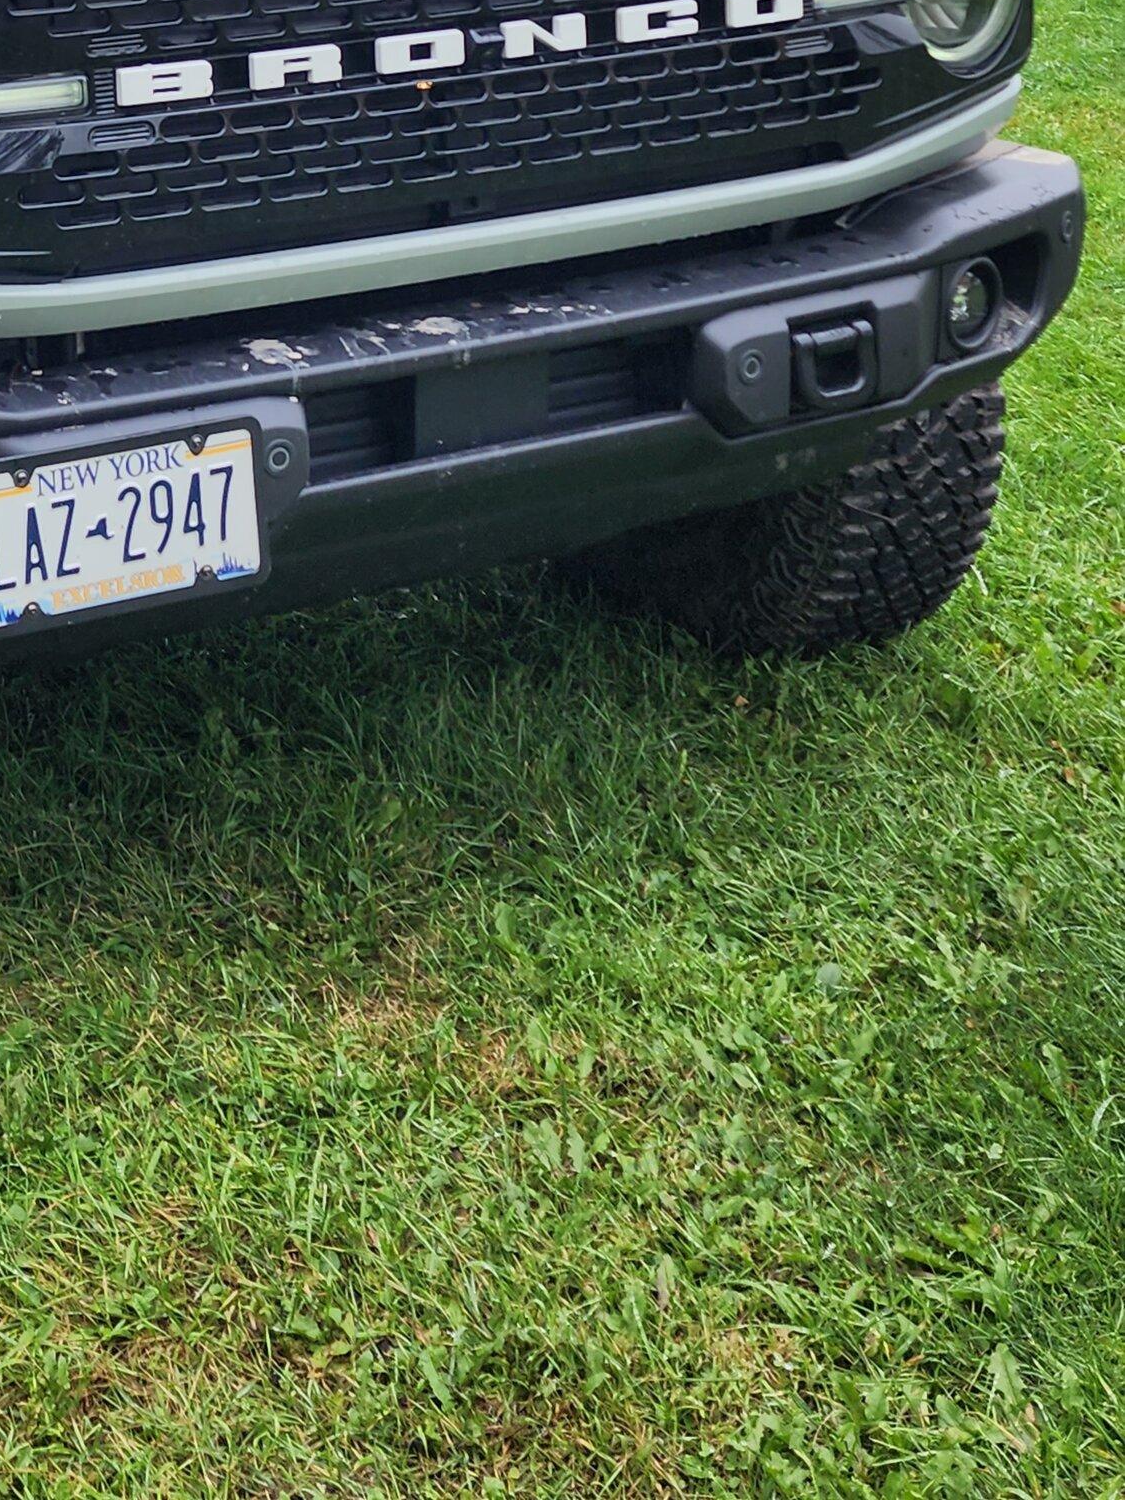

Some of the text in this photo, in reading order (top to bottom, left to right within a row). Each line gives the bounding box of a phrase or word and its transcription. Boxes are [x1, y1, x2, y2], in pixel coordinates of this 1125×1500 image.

[37, 443, 185, 497] NEW YORK
[117, 464, 234, 563] 2947
[51, 563, 186, 610] EXCELSIOR
